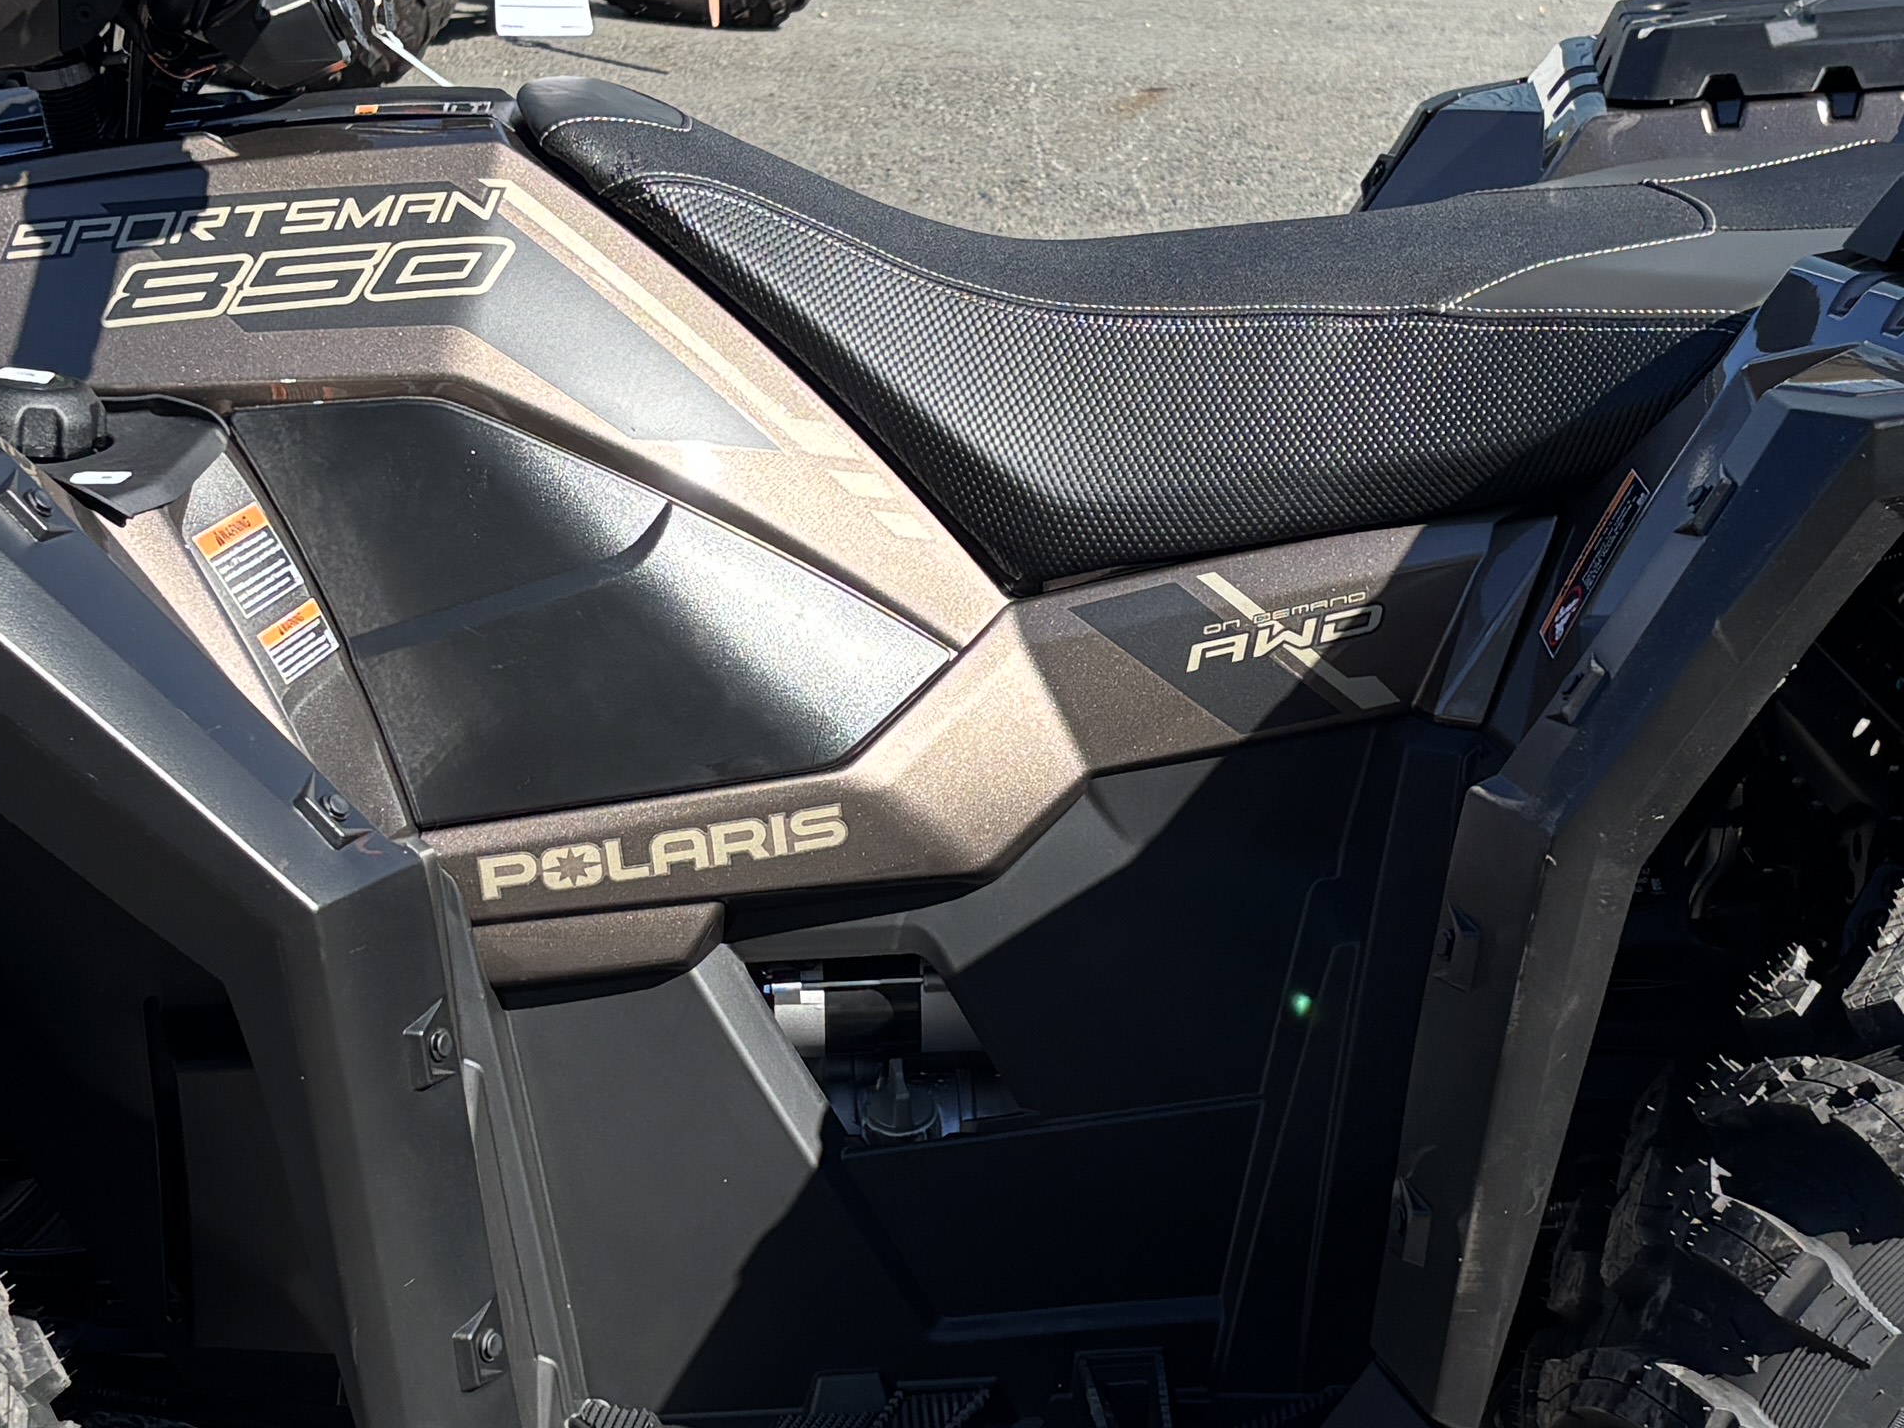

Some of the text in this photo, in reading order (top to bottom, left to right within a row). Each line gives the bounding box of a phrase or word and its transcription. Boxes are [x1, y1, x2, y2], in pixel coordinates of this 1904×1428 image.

[5, 184, 501, 261] SPORTSMAN
[100, 235, 517, 329] 850
[1185, 603, 1385, 673] AWD
[1203, 590, 1366, 636] ON DEMAND
[476, 802, 849, 901] POLARIS
